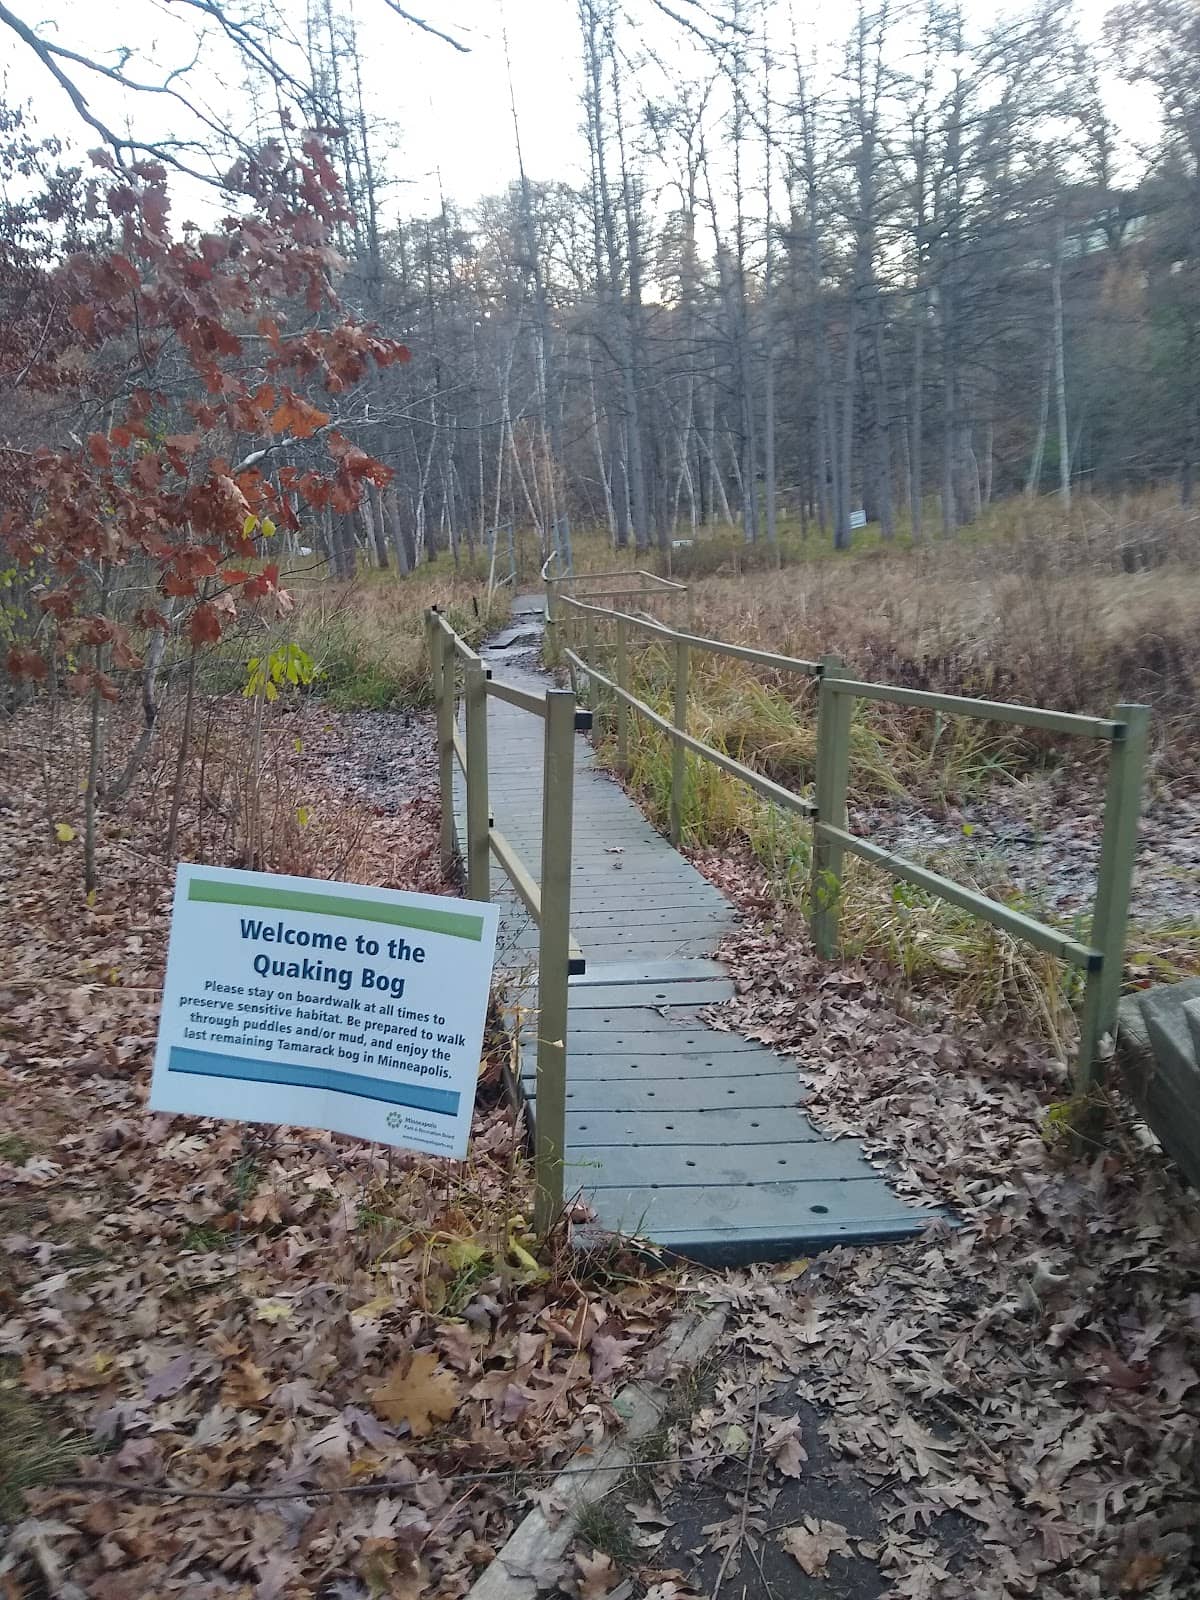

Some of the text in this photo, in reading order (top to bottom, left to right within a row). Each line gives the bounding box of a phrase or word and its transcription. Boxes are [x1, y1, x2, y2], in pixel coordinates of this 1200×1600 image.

[240, 918, 426, 963] Welcome to the
[254, 954, 405, 998] Quaking Bog
[180, 994, 466, 1046] preserve sensitive habitat. Be prepared to walk
[204, 981, 445, 1025] Please stay on boardwalk at all times to
[184, 1028, 452, 1079] last remaining Tamarack bog in Minneapolis.
[190, 1012, 451, 1061] through puddles and/or mud, and enjoy the
